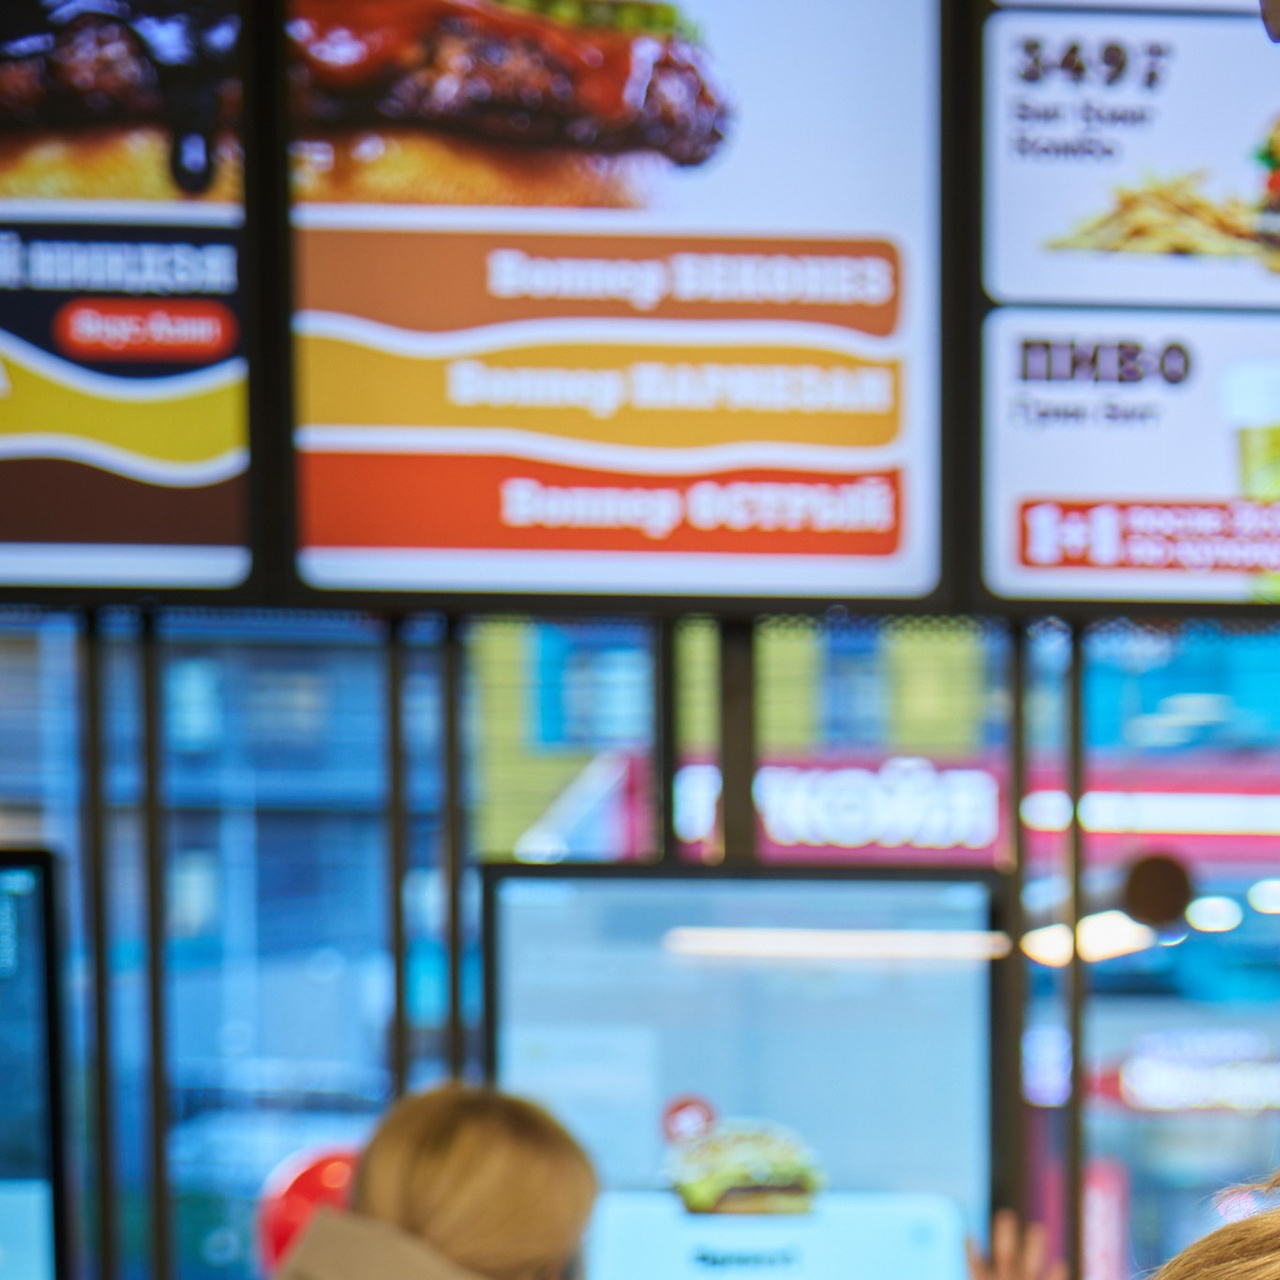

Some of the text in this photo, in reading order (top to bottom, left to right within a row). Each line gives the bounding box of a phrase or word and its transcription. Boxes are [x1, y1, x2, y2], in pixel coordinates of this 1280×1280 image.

[487, 249, 667, 310] Воппер
[449, 360, 892, 417] Воппер ПАРМЕЗАН
[1020, 338, 1190, 385] ПИВО
[501, 476, 893, 538] Воппер ОСТРЫЙ
